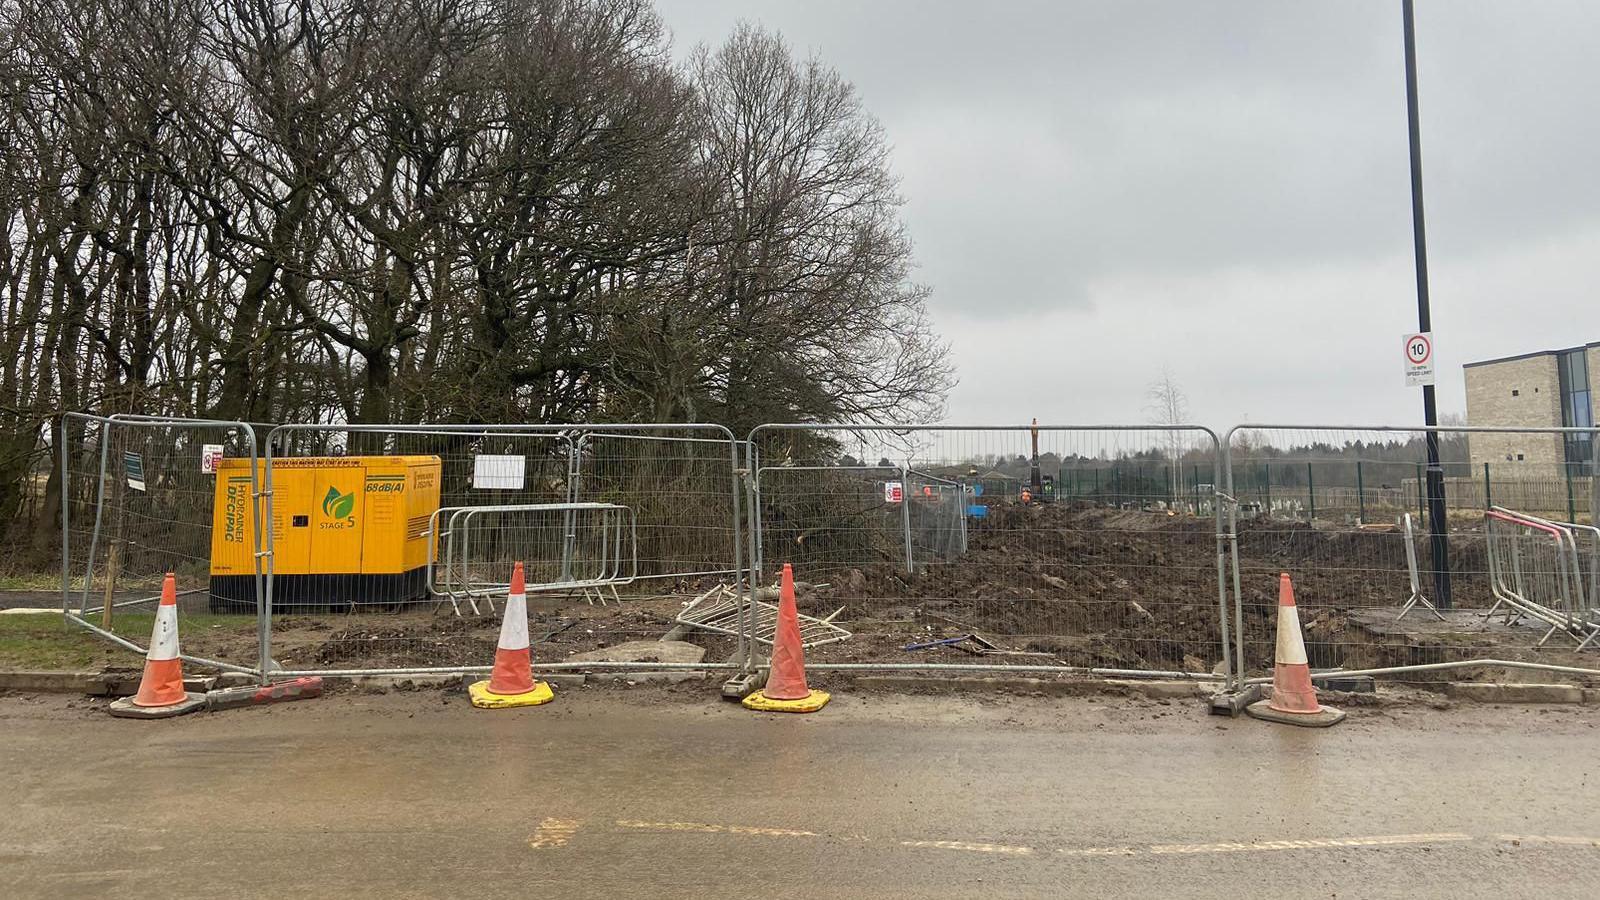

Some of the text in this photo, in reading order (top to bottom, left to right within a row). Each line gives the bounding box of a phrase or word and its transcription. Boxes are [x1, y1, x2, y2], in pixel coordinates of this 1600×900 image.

[1411, 343, 1424, 355] 10
[366, 482, 404, 494] 68dB(A)
[225, 486, 237, 542] DECIPAC
[235, 485, 247, 543] HYDRAINER
[347, 516, 355, 528] 5
